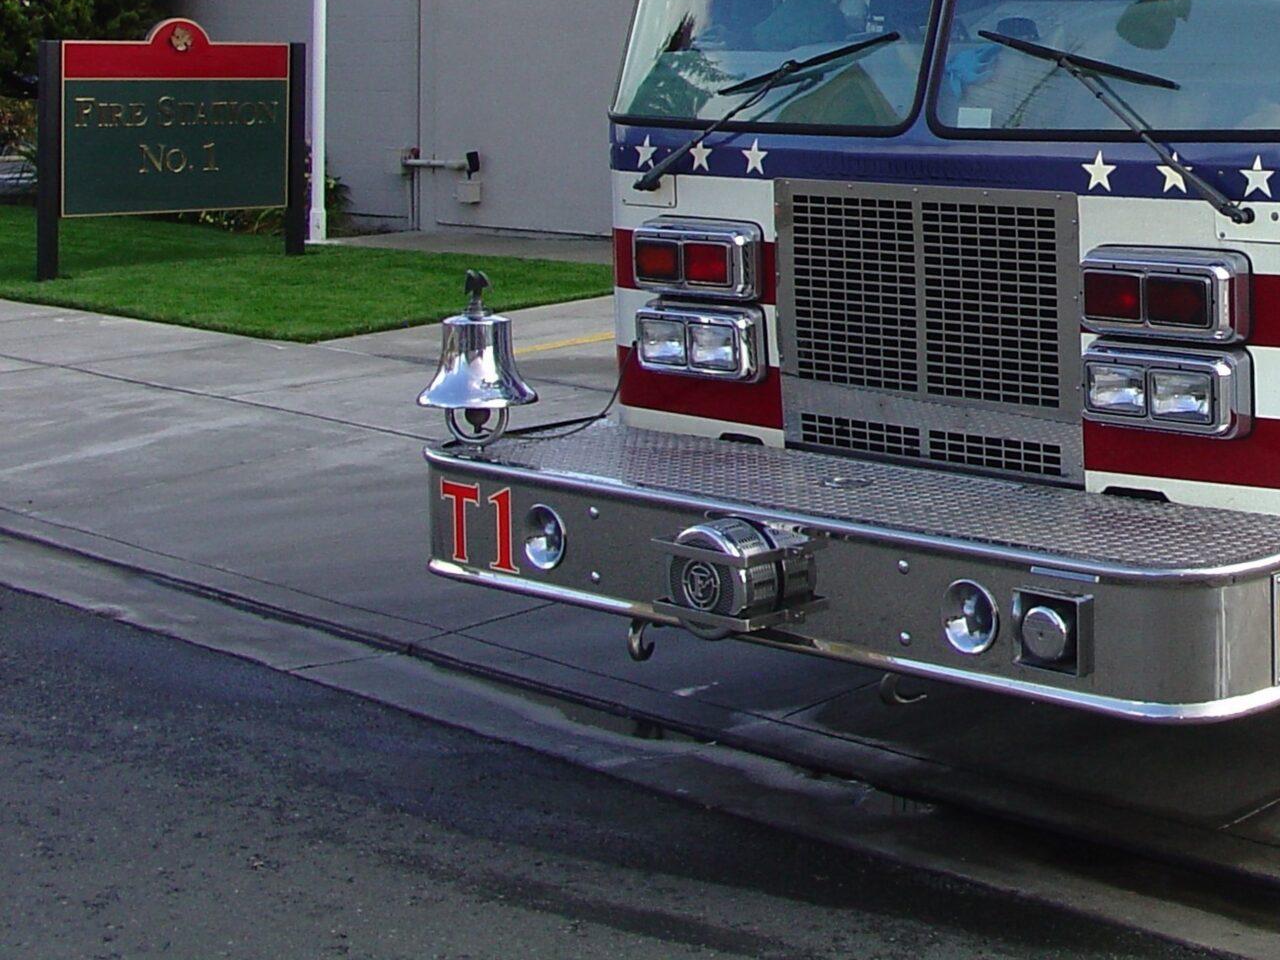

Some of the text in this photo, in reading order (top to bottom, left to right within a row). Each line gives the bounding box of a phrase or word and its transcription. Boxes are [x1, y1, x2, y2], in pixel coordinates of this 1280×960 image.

[74, 95, 280, 128] FIRE STATION
[202, 142, 220, 172] 1
[439, 476, 520, 574] T1
